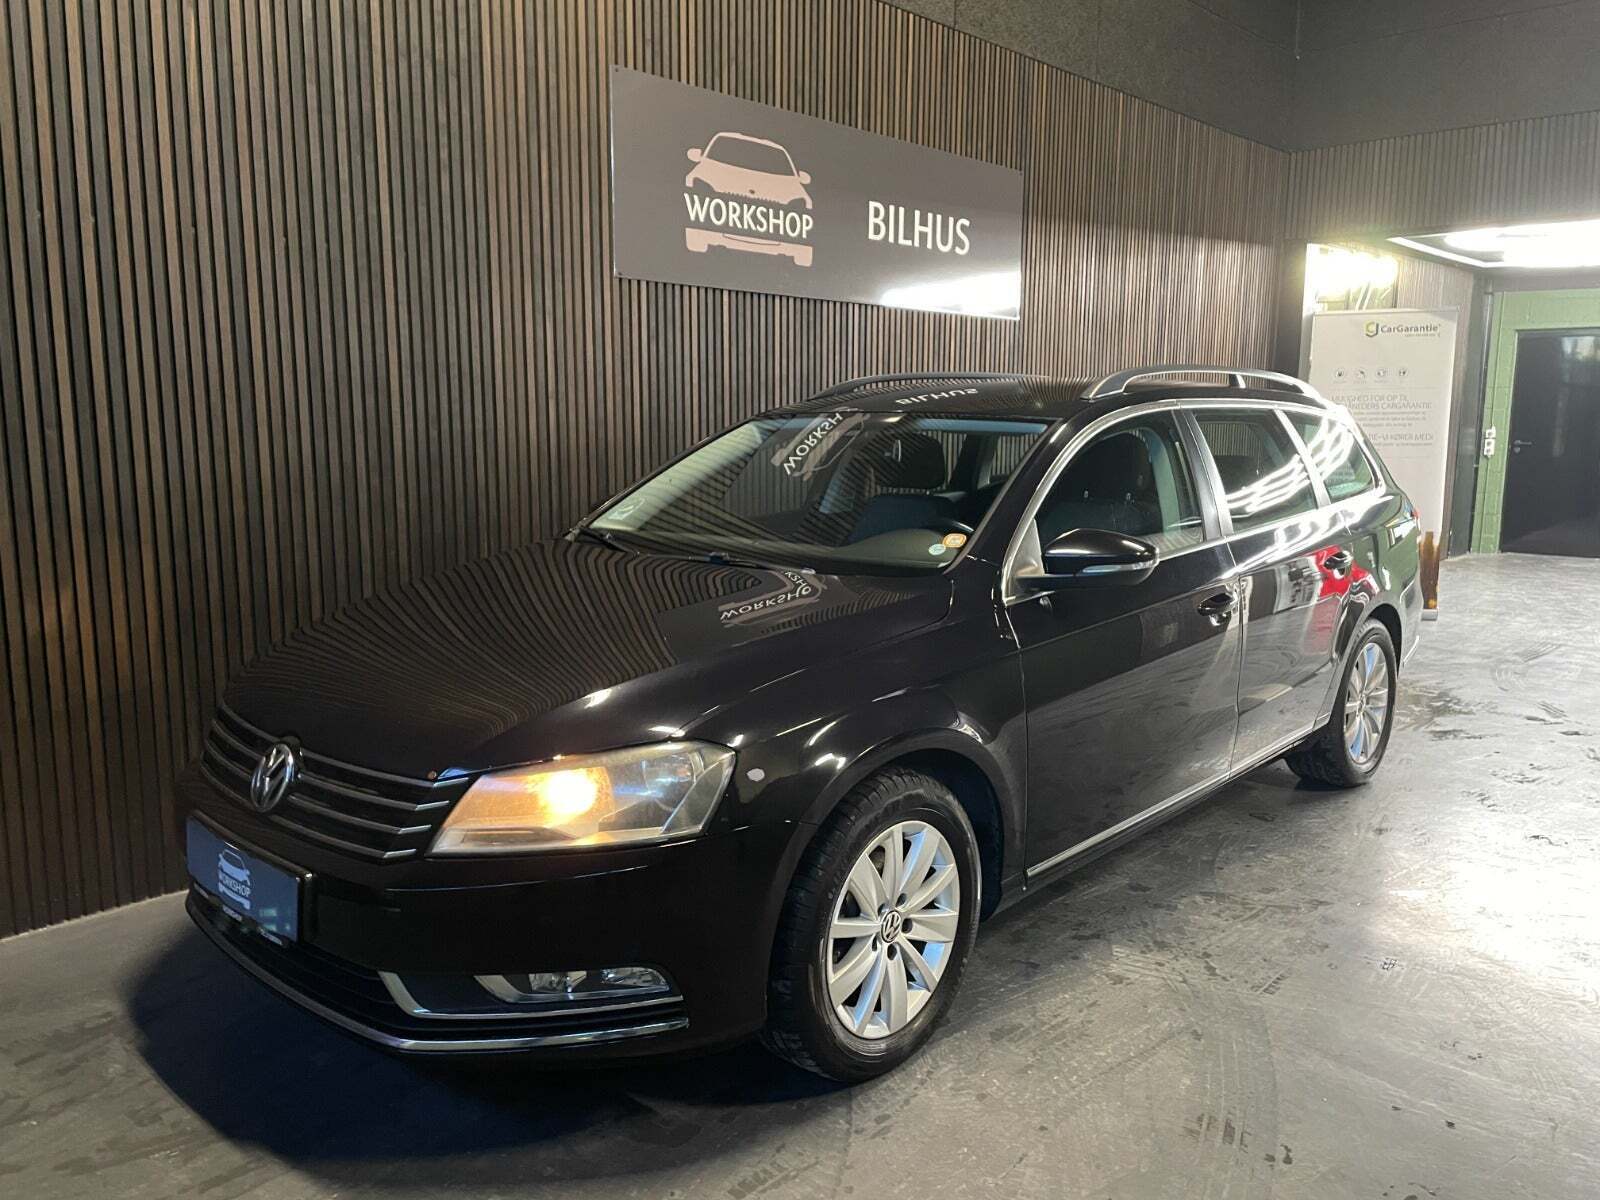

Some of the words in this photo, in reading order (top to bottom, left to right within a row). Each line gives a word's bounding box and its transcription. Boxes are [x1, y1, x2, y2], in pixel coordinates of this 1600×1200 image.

[684, 193, 813, 239] WORKSHOP
[868, 200, 970, 255] BILHUS
[1380, 323, 1438, 333] CarGarantie
